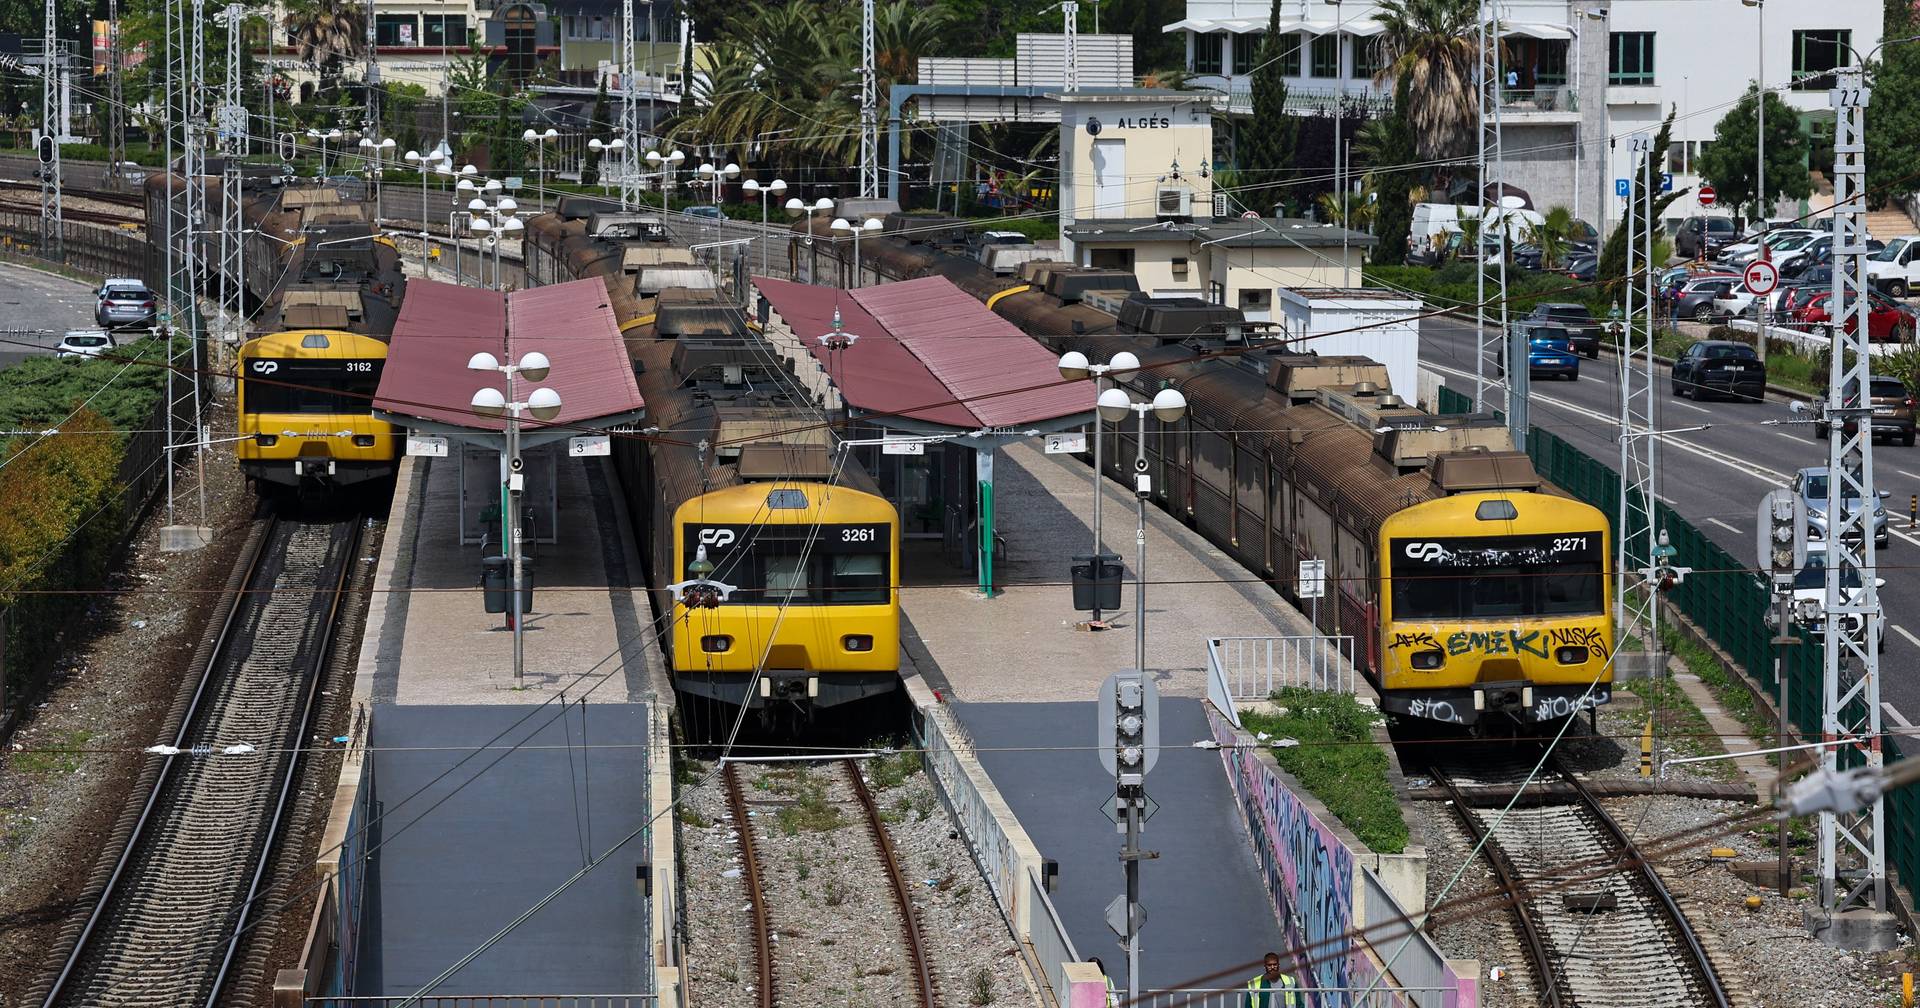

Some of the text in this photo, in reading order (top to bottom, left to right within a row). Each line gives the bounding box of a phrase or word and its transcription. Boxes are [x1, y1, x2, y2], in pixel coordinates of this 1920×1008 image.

[1841, 90, 1860, 106] 22
[1118, 112, 1169, 129] ALGÉS
[1633, 139, 1647, 151] 24
[1619, 181, 1626, 194] P
[253, 361, 278, 374] CP
[346, 362, 371, 372] 3162
[433, 443, 439, 453] 1
[576, 443, 584, 453] 3
[909, 442, 916, 451] 3
[1052, 441, 1060, 450] 2
[698, 528, 735, 548] CP
[841, 528, 875, 542] 3261
[1553, 537, 1586, 552] 3271
[1405, 542, 1443, 562] CP
